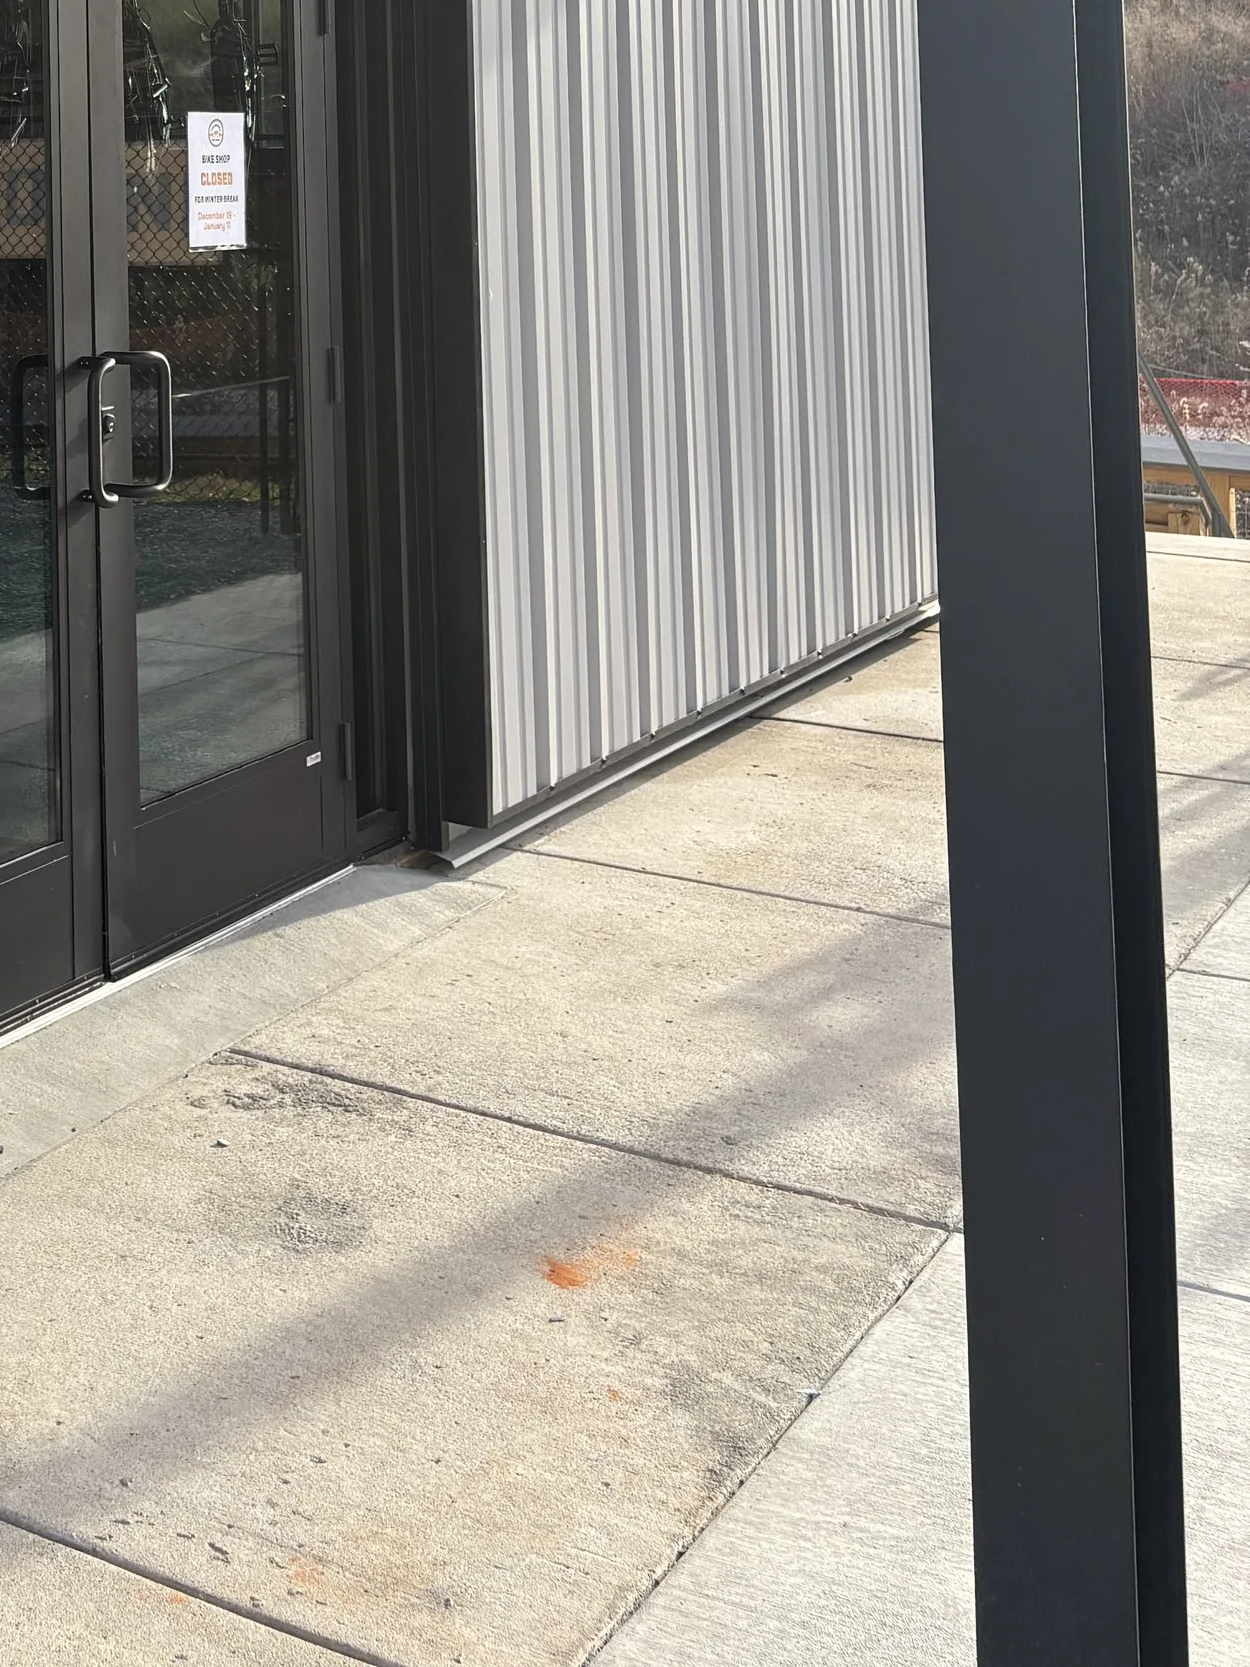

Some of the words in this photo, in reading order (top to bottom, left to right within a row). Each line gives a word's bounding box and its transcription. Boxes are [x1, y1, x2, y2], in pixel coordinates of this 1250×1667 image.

[202, 155, 215, 164] BIKE
[215, 155, 231, 164] SHOP
[201, 172, 233, 186] CLOSED
[198, 212, 225, 221] December
[203, 222, 225, 232] January
